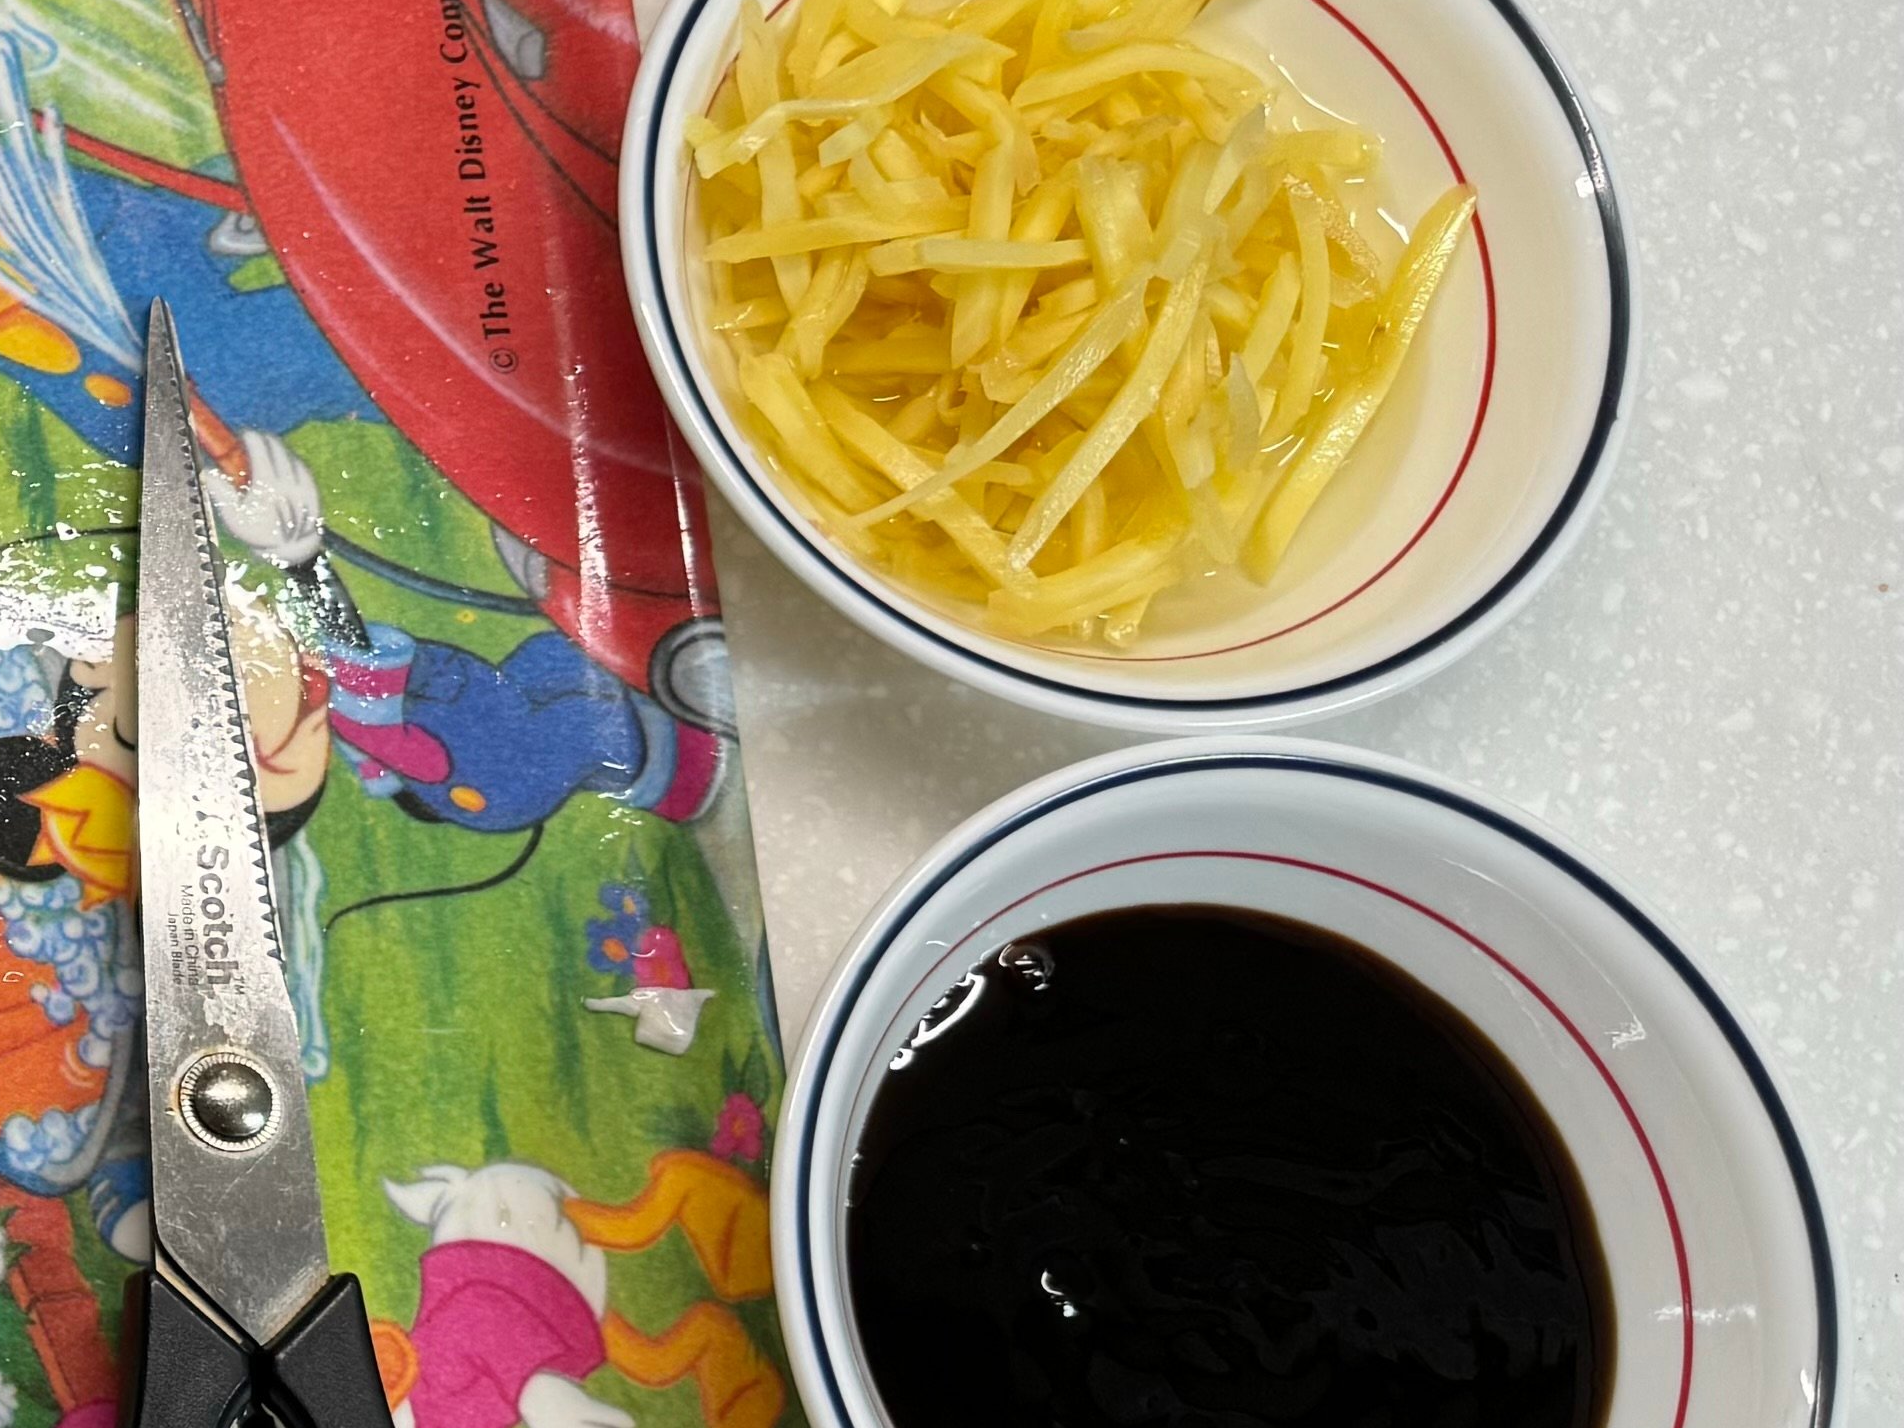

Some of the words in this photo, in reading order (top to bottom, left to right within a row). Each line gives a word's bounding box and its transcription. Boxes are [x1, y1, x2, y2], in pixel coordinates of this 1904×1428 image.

[454, 76, 483, 182] Disney
[462, 194, 501, 272] Walt
[478, 280, 514, 341] The
[180, 884, 196, 925] Made
[197, 844, 239, 985] Scotch
[166, 912, 180, 947] Japan
[184, 929, 197, 941] in
[171, 951, 184, 986] Blade
[185, 944, 201, 986] China
